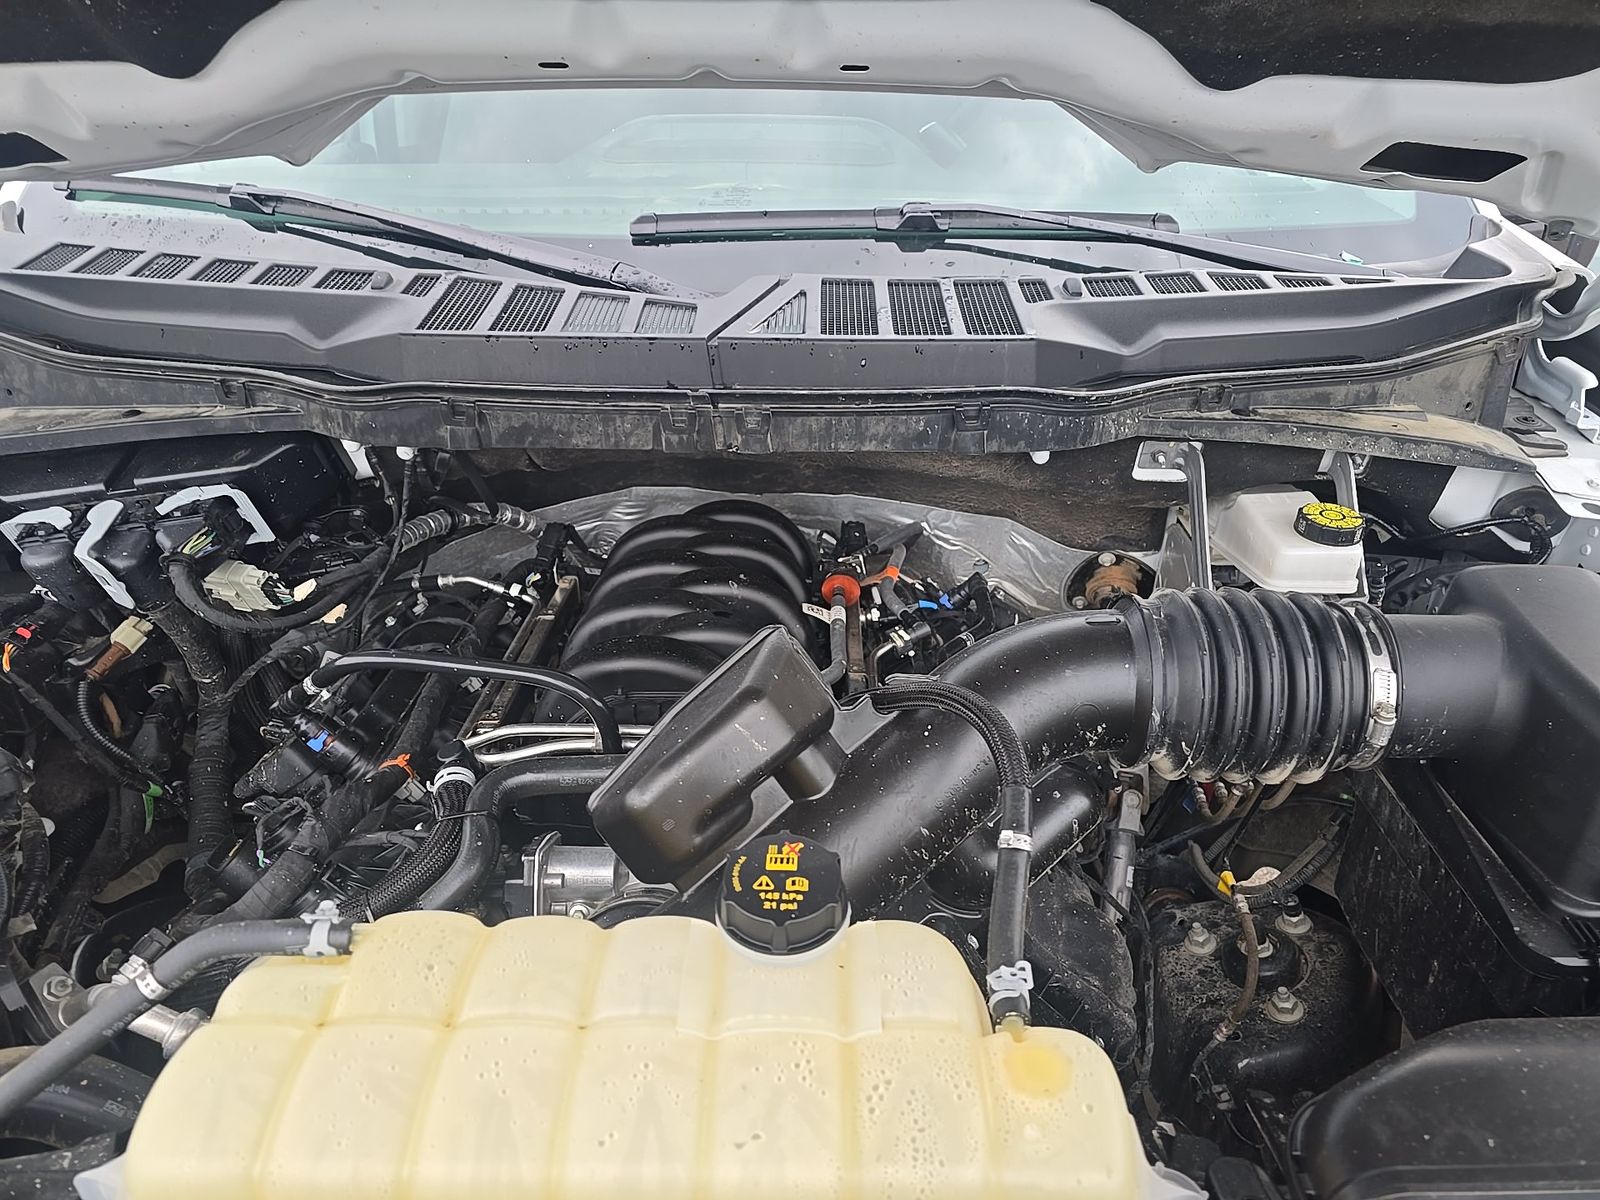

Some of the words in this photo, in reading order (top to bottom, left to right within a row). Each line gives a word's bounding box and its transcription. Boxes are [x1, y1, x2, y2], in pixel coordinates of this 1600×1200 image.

[781, 892, 804, 901] kPa
[763, 901, 777, 910] 21
[779, 902, 798, 911] psi
